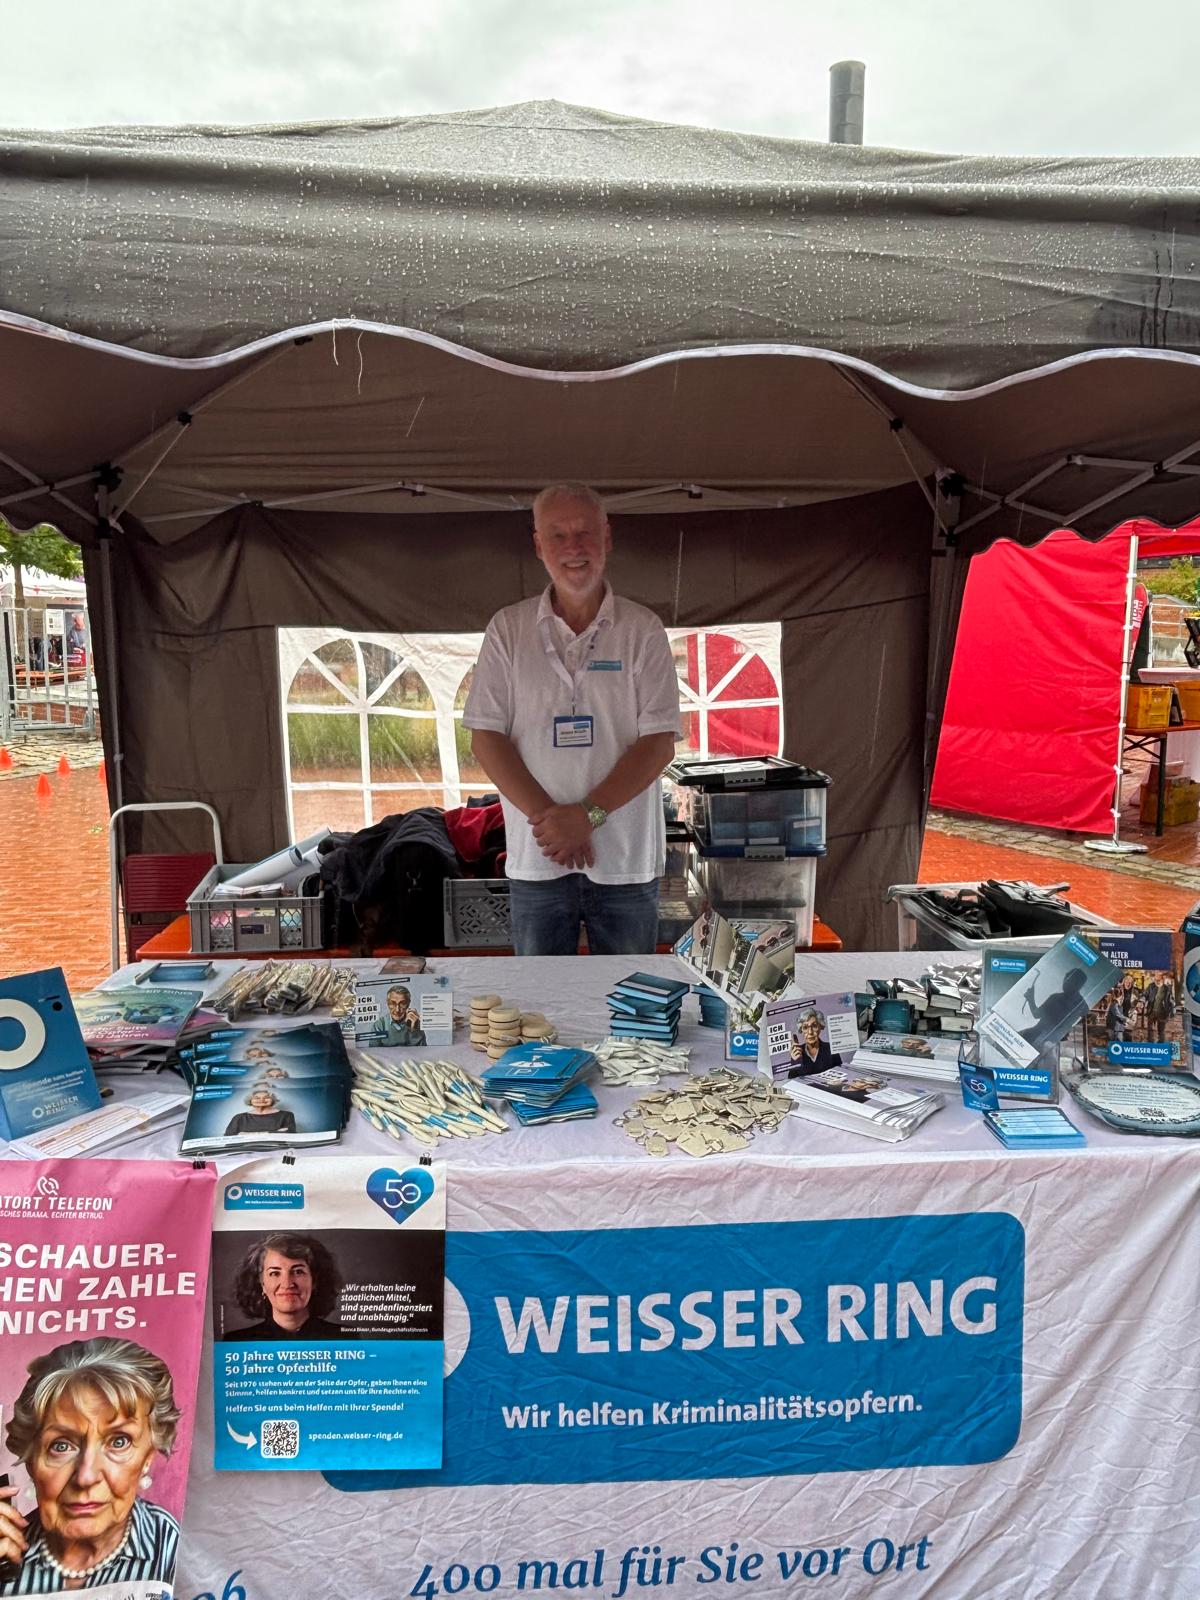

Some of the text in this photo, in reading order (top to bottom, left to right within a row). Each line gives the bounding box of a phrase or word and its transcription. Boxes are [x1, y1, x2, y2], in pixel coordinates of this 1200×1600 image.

[1111, 951, 1128, 959] ALTER
[1124, 960, 1142, 968] LEBEN
[358, 996, 372, 1004] ICH
[770, 1034, 790, 1043] LEGE
[772, 1044, 789, 1053] AUF!
[1124, 1046, 1151, 1054] WEISSER
[999, 1072, 1048, 1083] WEISSER RING
[244, 1189, 279, 1197] WEISSER
[383, 1179, 421, 1209] 50
[0, 1196, 112, 1211] TORT TELEFON
[78, 1212, 104, 1220] BETRUG.
[77, 1272, 196, 1300] ZAHLE
[360, 1284, 394, 1292] erhalten
[394, 1284, 416, 1292] keine
[340, 1293, 412, 1303] staatlichen Mittel,
[340, 1303, 433, 1313] sind spendenfinanziert
[340, 1312, 358, 1321] und
[493, 1275, 998, 1354] WEISSER RING
[0, 1306, 147, 1335] NICHTS.
[225, 1352, 240, 1364] 50
[242, 1351, 274, 1362] Jahre
[277, 1350, 332, 1361] WEISSER
[335, 1350, 366, 1360] RING
[225, 1362, 336, 1376] 50 Jahre Opferhilfe
[348, 1379, 370, 1387] Opfer,
[225, 1404, 253, 1412] Helfen
[254, 1404, 267, 1412] Sie
[284, 1404, 305, 1412] beim
[350, 1403, 370, 1411] Ihrer
[371, 1403, 404, 1412] Spende!
[502, 1389, 924, 1430] Wir helfen Kriminalitätsopfern.
[308, 1431, 404, 1442] spenden.weisser-ring.de
[409, 1534, 934, 1600] 400 mal für Sie vor Ort
